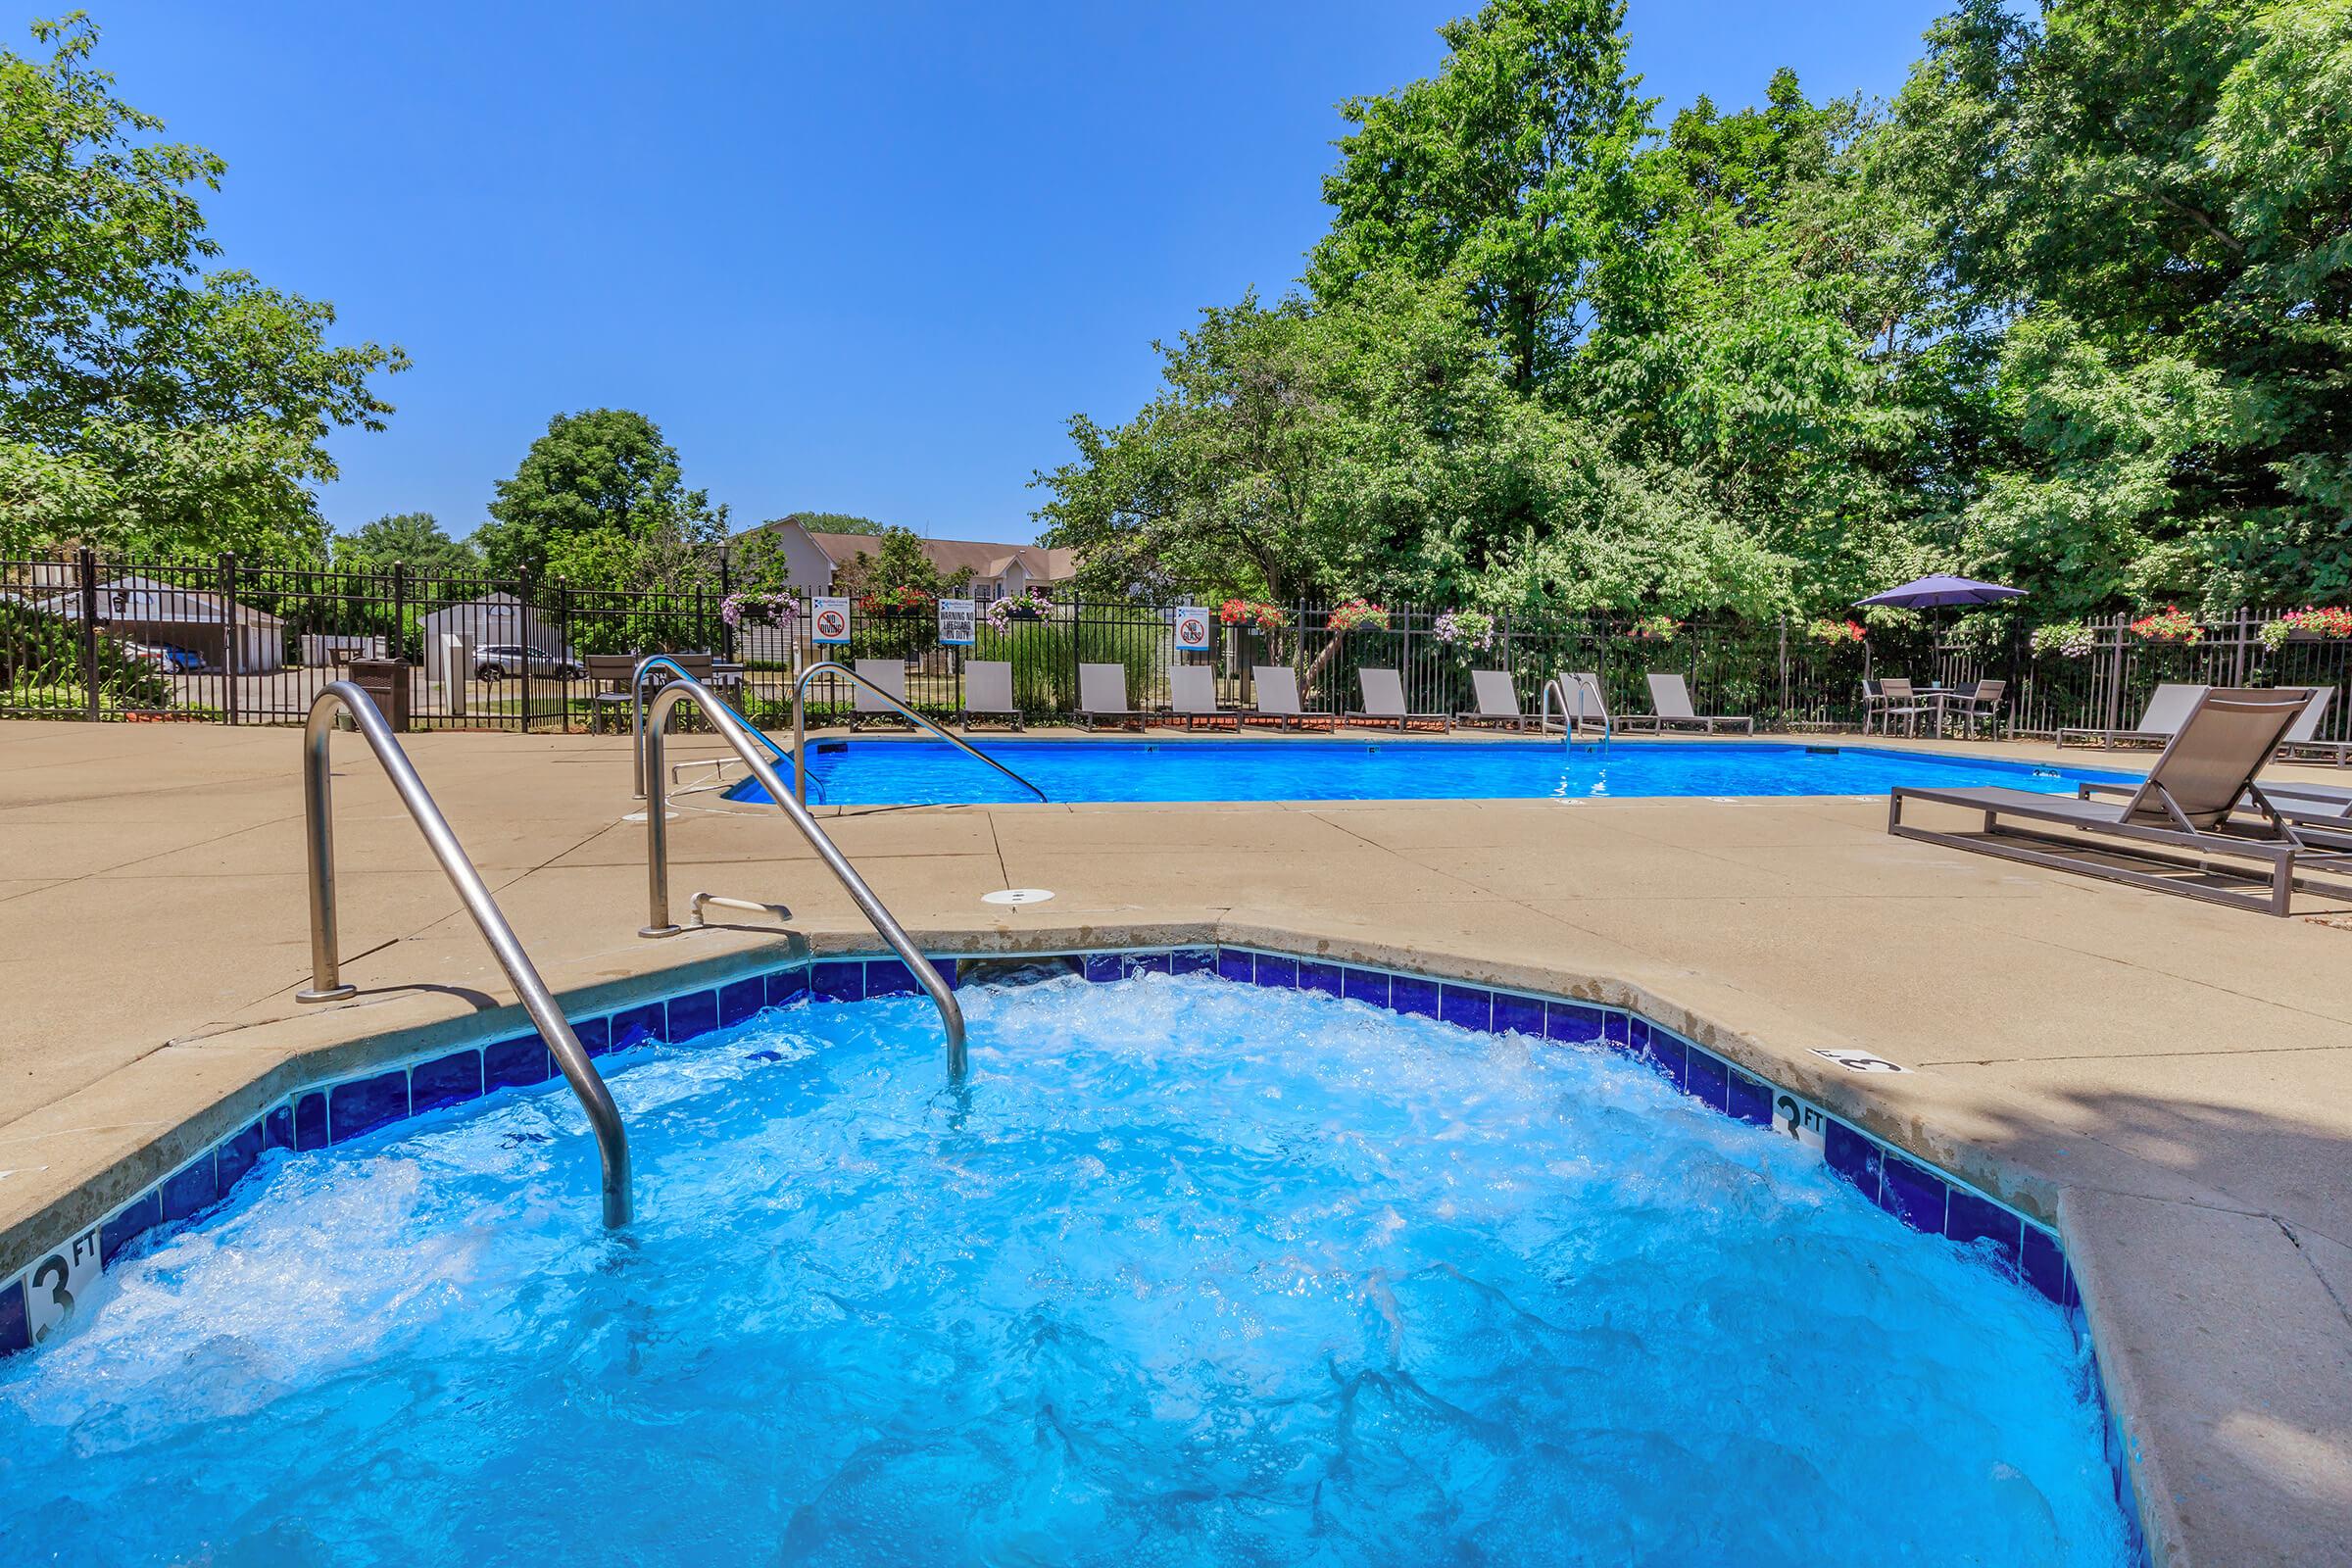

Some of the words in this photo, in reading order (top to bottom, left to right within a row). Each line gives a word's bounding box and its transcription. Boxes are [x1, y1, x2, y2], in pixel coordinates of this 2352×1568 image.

[826, 614, 836, 623] NO
[941, 612, 965, 620] WARNING
[965, 612, 974, 621] NO
[944, 620, 970, 630] LIFEGUARD
[947, 630, 955, 639] ON
[956, 630, 970, 640] DUTY
[1804, 1106, 1823, 1132] FT
[32, 1253, 75, 1344] 3
[73, 1229, 97, 1267] FT
